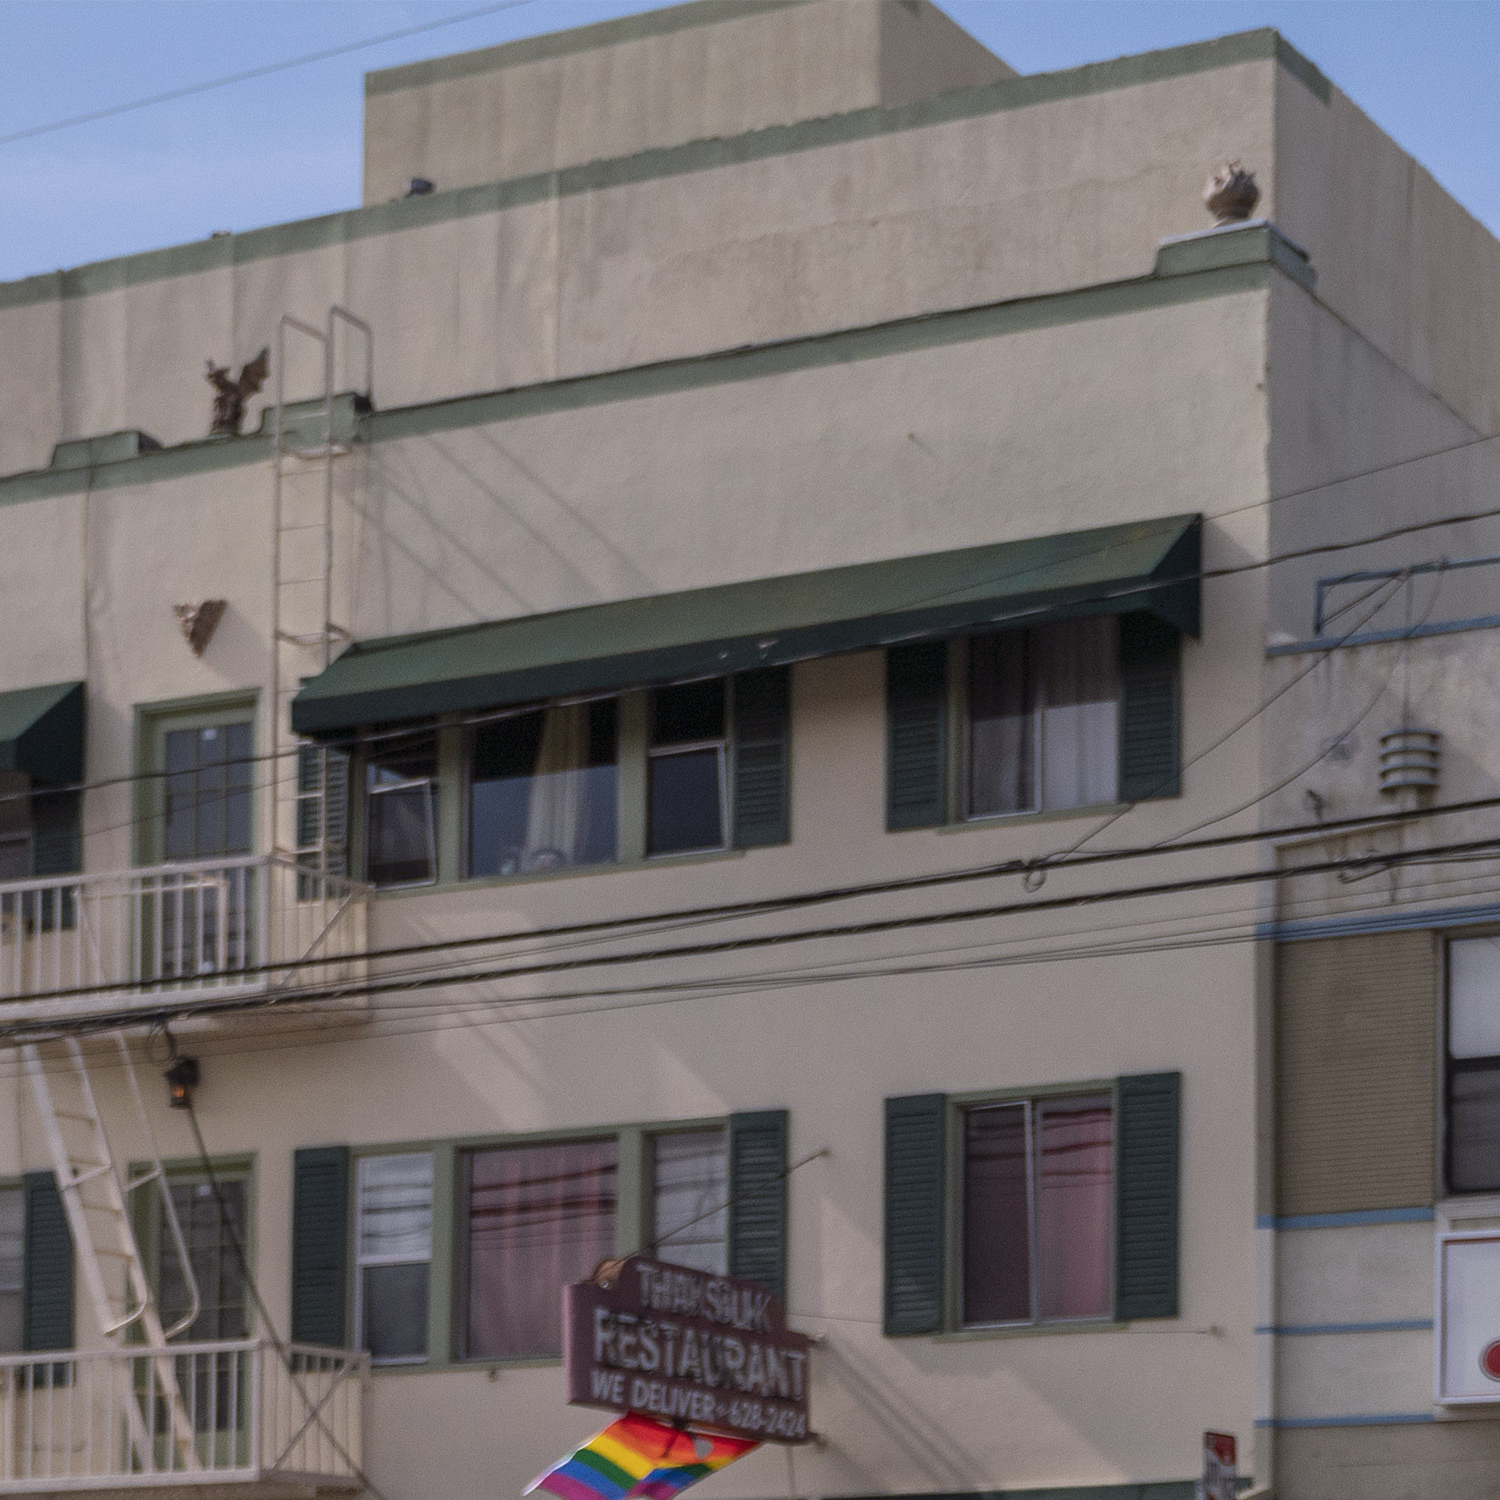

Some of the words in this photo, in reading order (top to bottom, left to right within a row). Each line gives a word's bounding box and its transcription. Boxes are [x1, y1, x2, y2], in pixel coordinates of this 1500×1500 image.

[593, 1308, 806, 1401] RESTAURANT
[591, 1369, 625, 1404] WE
[630, 1378, 717, 1423] DELIVER
